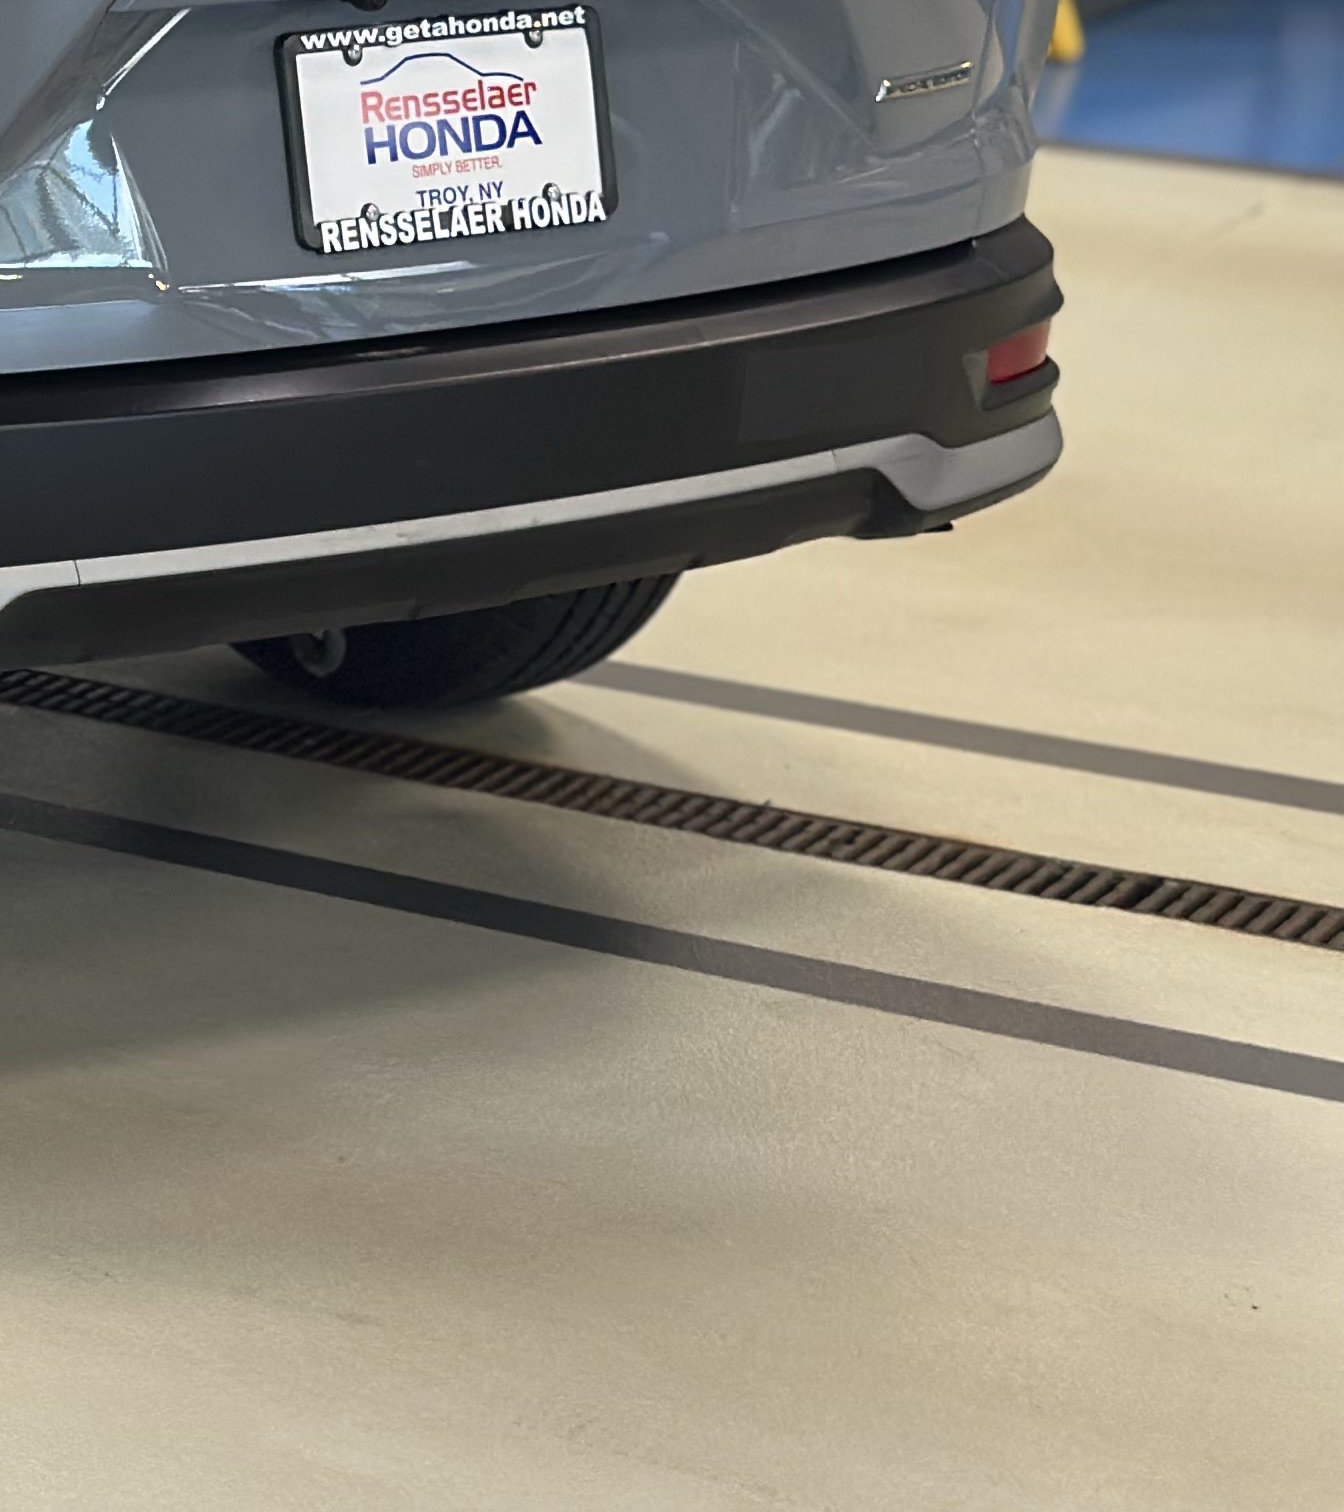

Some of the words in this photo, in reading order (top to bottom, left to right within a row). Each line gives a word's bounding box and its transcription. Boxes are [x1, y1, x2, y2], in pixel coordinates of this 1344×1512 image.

[300, 5, 586, 50] www.getahonda.net
[360, 80, 538, 125] Rensselaer
[365, 110, 543, 166] HONDA
[412, 161, 453, 179] SIMPLY
[478, 180, 503, 201] NY
[320, 201, 505, 253] RENSSELAER
[511, 191, 607, 231] HONDA
